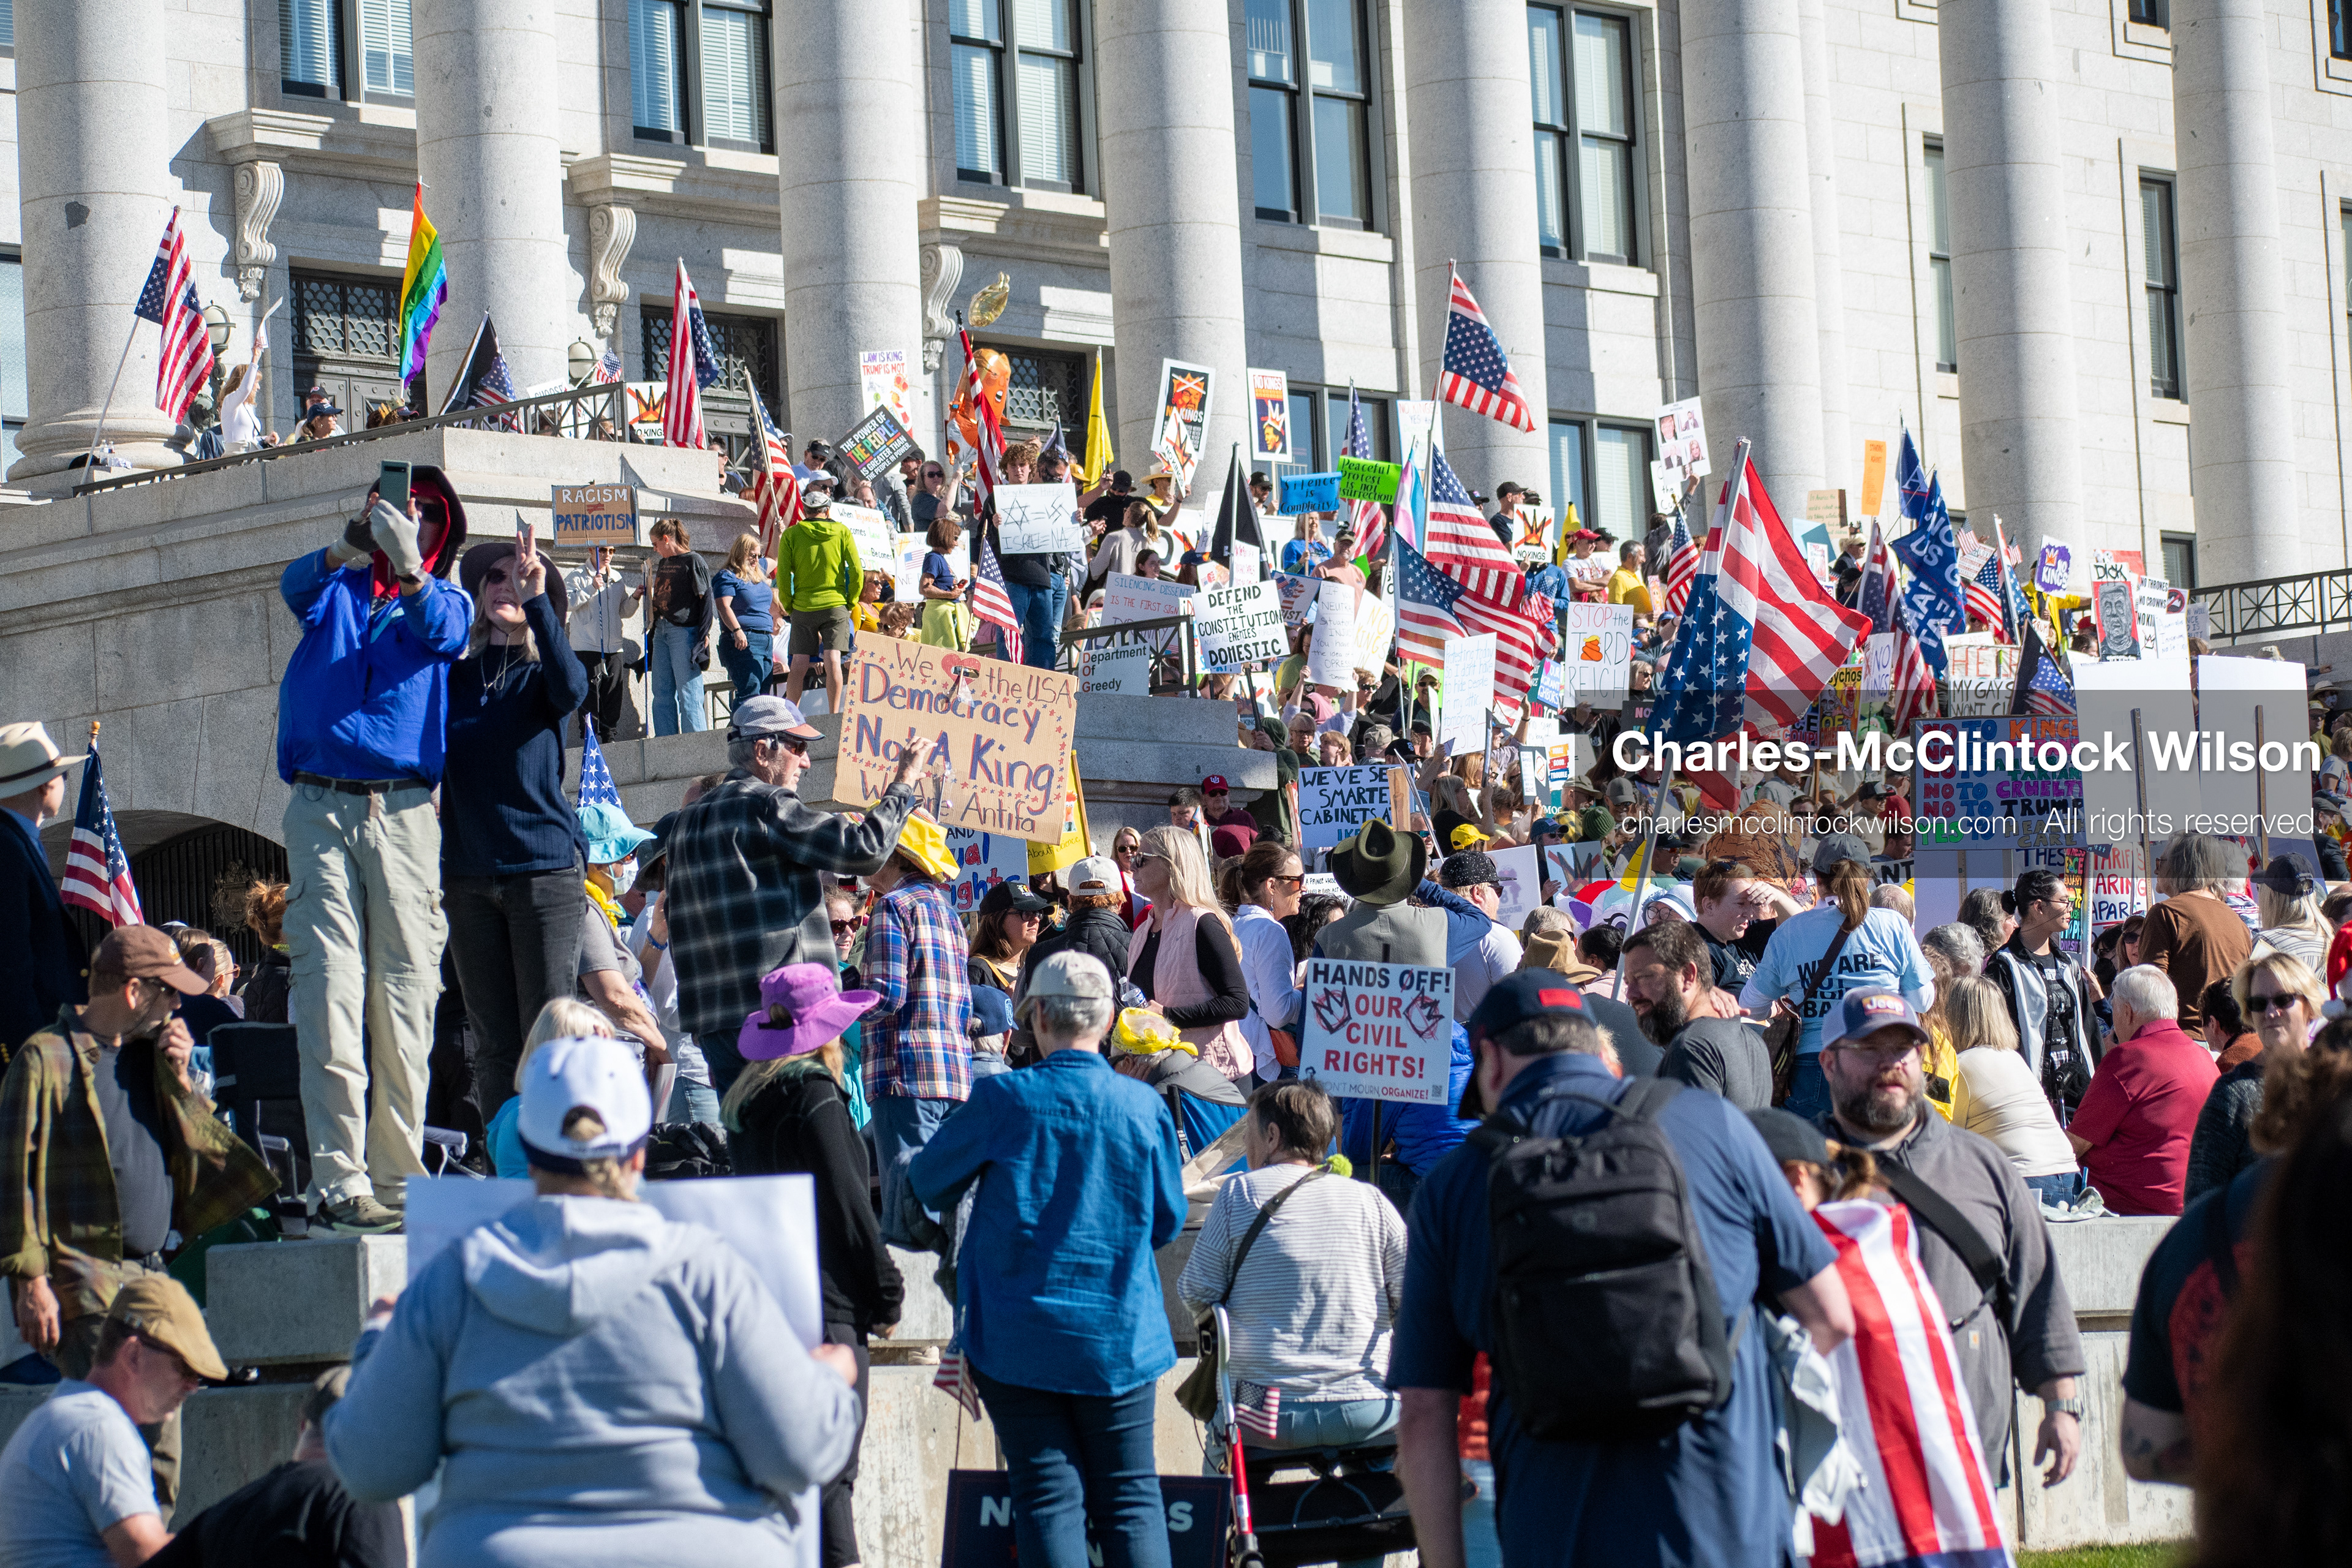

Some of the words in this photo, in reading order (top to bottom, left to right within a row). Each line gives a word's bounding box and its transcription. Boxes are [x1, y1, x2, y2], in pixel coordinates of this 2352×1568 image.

[862, 352, 878, 363] LAW
[878, 352, 885, 362] IS
[887, 350, 903, 362] KING
[862, 364, 883, 375] TRUMP
[883, 364, 890, 374] IS
[891, 363, 905, 374] NOT
[1254, 376, 1264, 388] NO
[1264, 377, 1282, 391] KINGS
[1180, 408, 1204, 423] KINGS
[1399, 402, 1409, 414] NO
[1409, 415, 1421, 424] YES
[840, 439, 856, 453] THE
[853, 419, 879, 443] POWER
[875, 411, 888, 424] OF
[846, 443, 870, 466] THE
[862, 419, 899, 454] PEOPLE
[860, 466, 870, 477] IS
[867, 448, 893, 471] GREATER
[890, 435, 907, 454] THAN
[865, 470, 876, 482] THE
[875, 458, 891, 475] PEOPLE
[889, 454, 897, 463] IN
[1165, 446, 1173, 460] NO
[1172, 461, 1185, 487] KINGS
[1286, 477, 1336, 491] Silence
[1305, 488, 1314, 497] is
[1360, 481, 1378, 493] not
[1662, 485, 1675, 494] the
[562, 489, 627, 503] RACISM
[838, 508, 854, 518] When
[556, 513, 635, 532] PATRIOTISM
[871, 548, 893, 560] Becomes
[1517, 550, 1527, 559] NO
[1528, 551, 1546, 560] KINGS
[898, 573, 911, 586] WE
[2041, 566, 2069, 589] KINGS
[2094, 564, 2127, 581] DICK
[1115, 578, 1155, 592] SILENCING
[1160, 585, 1191, 598] DISSENT
[2141, 577, 2147, 587] NO
[2148, 578, 2168, 592] THRONES
[1110, 595, 1120, 605] IS
[1123, 597, 1136, 608] THE
[1140, 600, 1161, 612] FIRST
[1163, 605, 1179, 615] SIGN
[1208, 586, 1261, 608] DEFEND
[2139, 595, 2145, 605] NO
[2146, 596, 2167, 609] CROWNS
[1226, 604, 1243, 615] THE
[1572, 604, 1613, 628] STOP
[1612, 612, 1629, 627] the
[1198, 609, 1283, 637] CONSTITUTION
[1366, 605, 1389, 635] NO
[2136, 612, 2146, 626] NO
[1228, 628, 1257, 643] ENEMIES
[1315, 638, 1329, 647] You
[1354, 622, 1389, 660] KINGS
[1082, 645, 1147, 664] Department
[1208, 639, 1281, 666] DOMESTIC
[1446, 643, 1474, 664] Protesting
[1476, 640, 1494, 663] today
[1872, 644, 1891, 675] NO
[895, 642, 933, 678] We
[986, 666, 1022, 699] the
[1027, 674, 1072, 709] USA
[1082, 665, 1095, 677] Of
[1445, 666, 1453, 679] So
[1454, 664, 1460, 677] I
[1479, 660, 1493, 674] have
[1550, 665, 1560, 679] OUR
[1082, 678, 1121, 693] Greedy
[1444, 680, 1451, 693] to
[1453, 679, 1466, 692] hide
[1468, 675, 1488, 689] people
[1569, 666, 1626, 699] REICH
[1953, 679, 1972, 703] MY
[859, 661, 1041, 745] Democracy
[1444, 698, 1451, 710] in
[1453, 698, 1463, 714] my
[1464, 695, 1481, 708] attic
[1531, 702, 1543, 718] NO
[1544, 706, 1558, 719] ICE
[1635, 707, 1652, 718] NO
[1822, 715, 1844, 728] OF
[1922, 723, 1958, 744] NO
[1962, 719, 1997, 742] TO
[2009, 717, 2079, 740] KINGS
[925, 729, 951, 771] A
[968, 733, 1055, 816] King
[1301, 768, 1363, 788] WE'VE
[1550, 771, 1568, 780] TROUBLE
[1923, 783, 1954, 799] NO
[1956, 782, 1988, 801] TO
[1996, 780, 2082, 799] CRUELTY
[960, 792, 1036, 834] Antifa
[1300, 807, 1377, 825] CABINETS
[1923, 801, 1956, 818] NO
[1960, 800, 1994, 818] TO
[2000, 798, 2084, 819] TRUMP
[946, 827, 975, 840] AND
[1917, 821, 1964, 846] YES
[1967, 820, 1995, 840] TO
[2004, 818, 2085, 838] HEALTH
[2018, 833, 2077, 848] CARE
[1027, 844, 1054, 859] About
[1838, 952, 1882, 974] ARE
[1313, 963, 1390, 989] HANDS
[1399, 969, 1451, 993] OFF!
[1355, 993, 1403, 1019] OUR
[1868, 998, 1905, 1013] Jeep
[1346, 1022, 1408, 1049] CIVIL
[1324, 1049, 1425, 1079] RIGHTS!
[1381, 1087, 1429, 1100] ORGANIZE!
